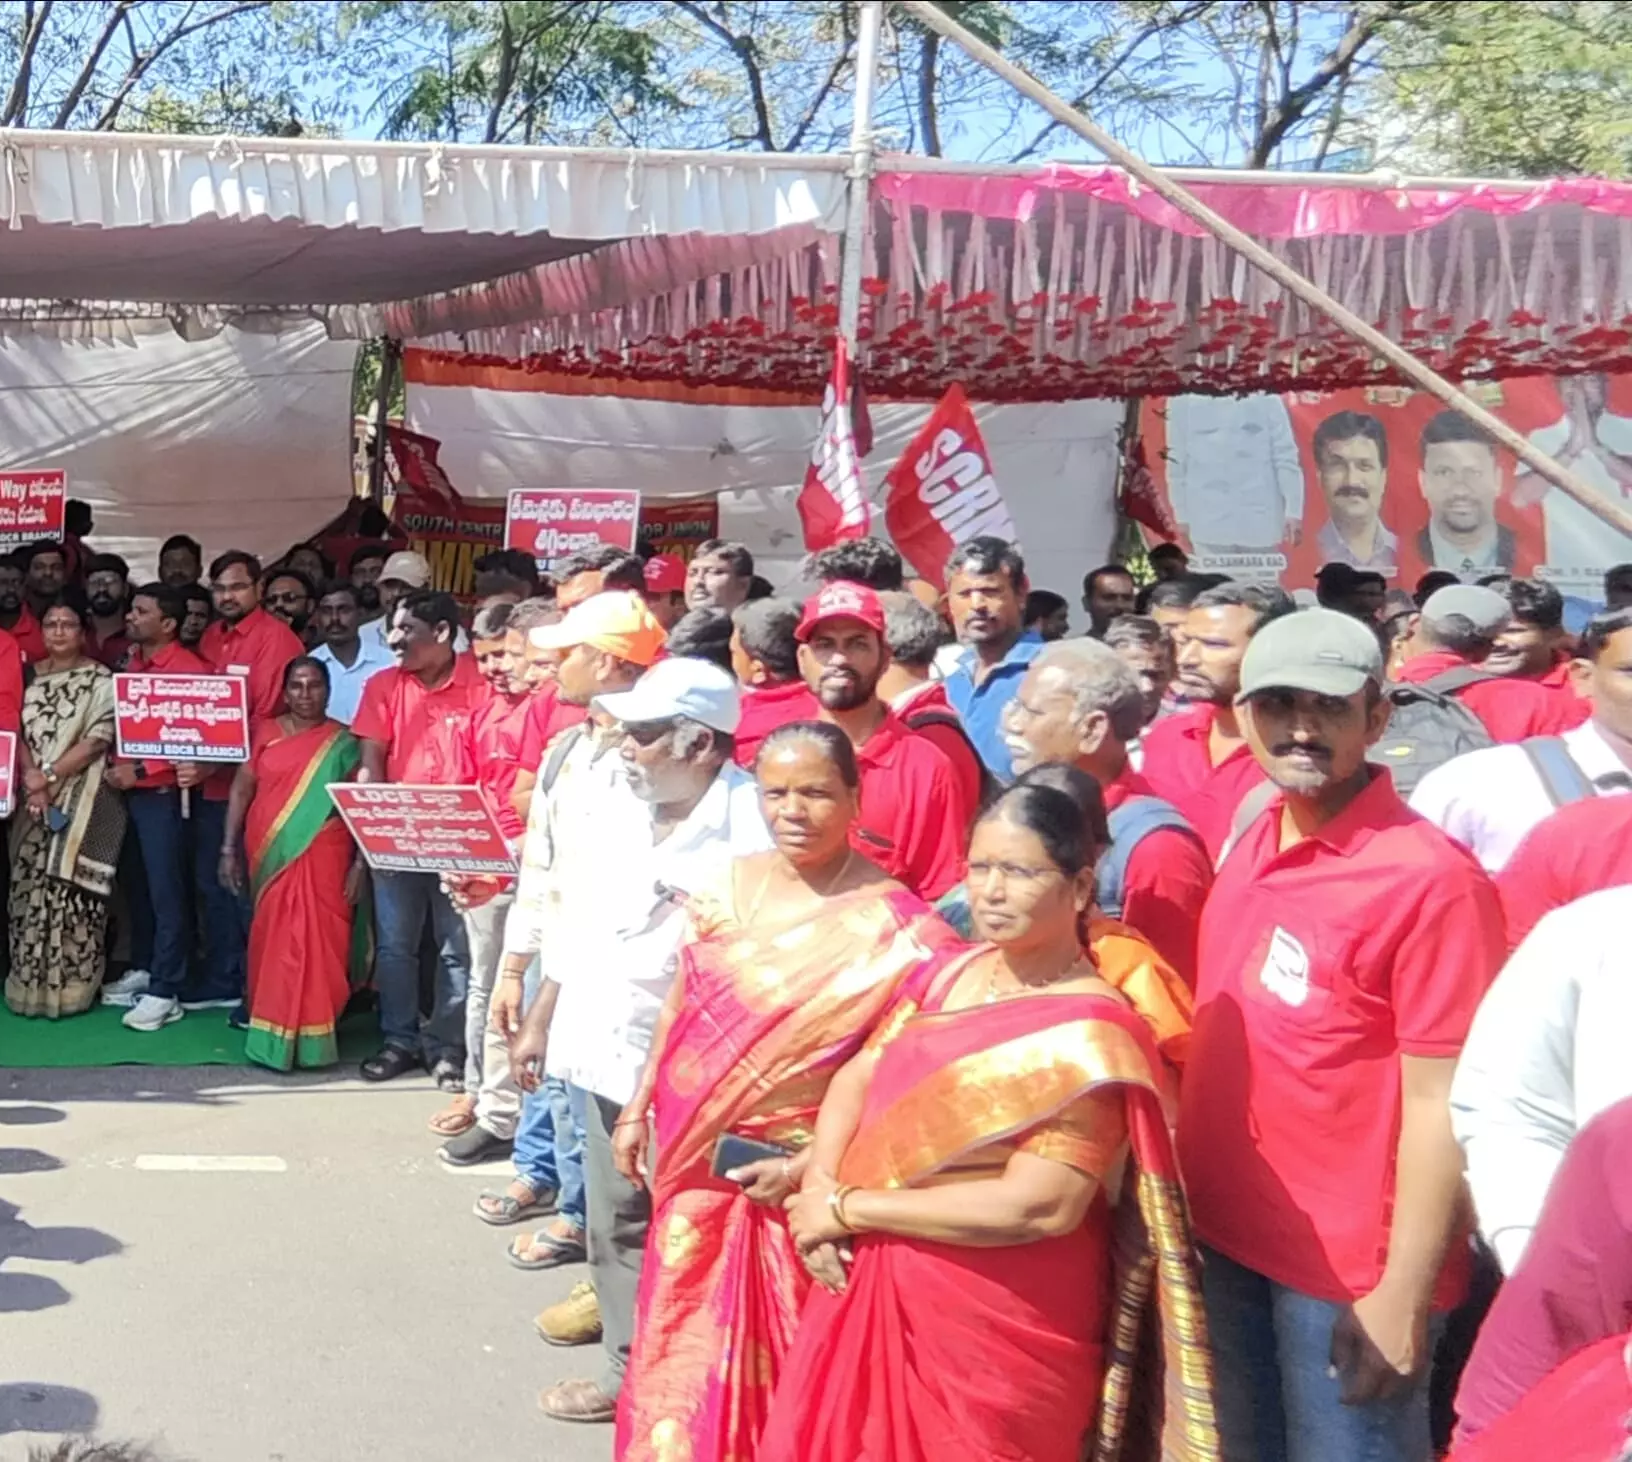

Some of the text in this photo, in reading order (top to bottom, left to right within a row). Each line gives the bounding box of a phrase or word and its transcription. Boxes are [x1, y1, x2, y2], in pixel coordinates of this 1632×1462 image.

[0, 479, 27, 503] Way
[21, 531, 61, 542] BRANCH
[459, 521, 504, 538] CENTR
[123, 743, 244, 757] SCRMU BDCR BRANCH
[350, 789, 417, 804] LDCE
[455, 859, 515, 872] BRANCH
